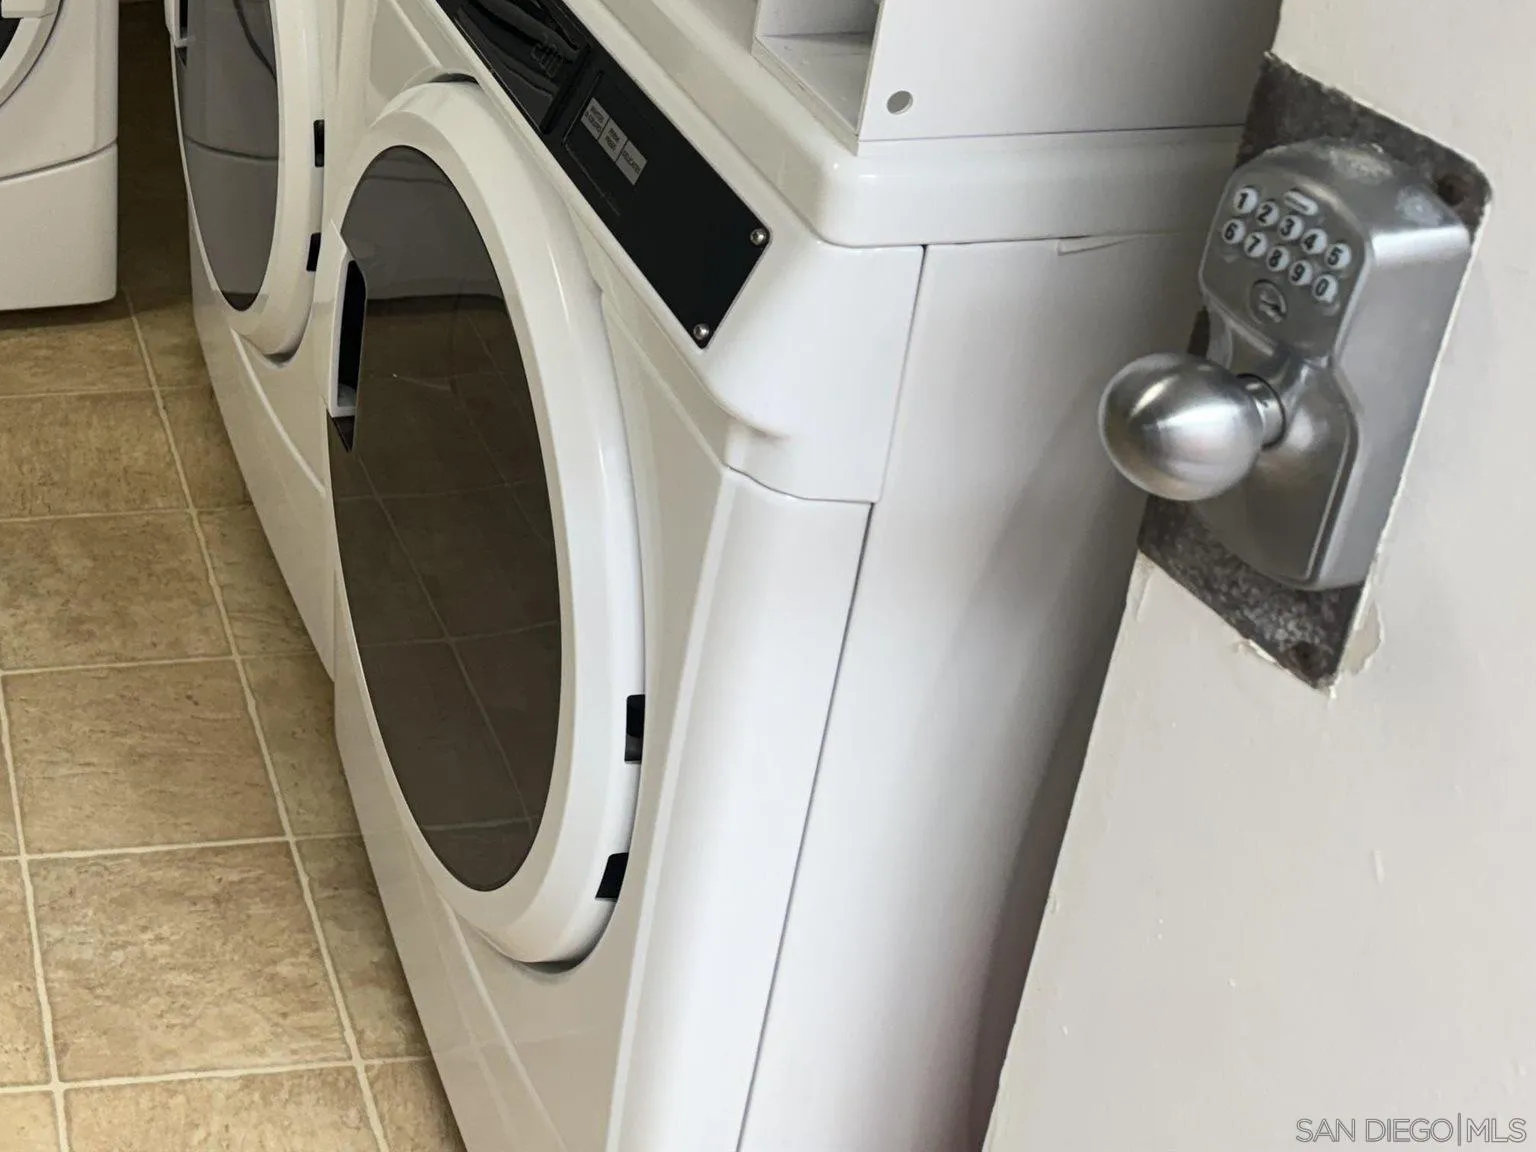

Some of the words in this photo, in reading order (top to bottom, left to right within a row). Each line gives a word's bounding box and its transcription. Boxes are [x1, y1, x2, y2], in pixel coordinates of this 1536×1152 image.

[1224, 222, 1238, 241] 6
[1248, 235, 1261, 253] 7
[1268, 249, 1282, 268] 8
[1292, 264, 1306, 282] 9
[1316, 278, 1330, 296] 0
[1237, 193, 1249, 209] 1
[1258, 205, 1274, 223] 2
[1280, 218, 1295, 236] 3
[1304, 233, 1318, 250] 4
[1328, 247, 1343, 266] 5
